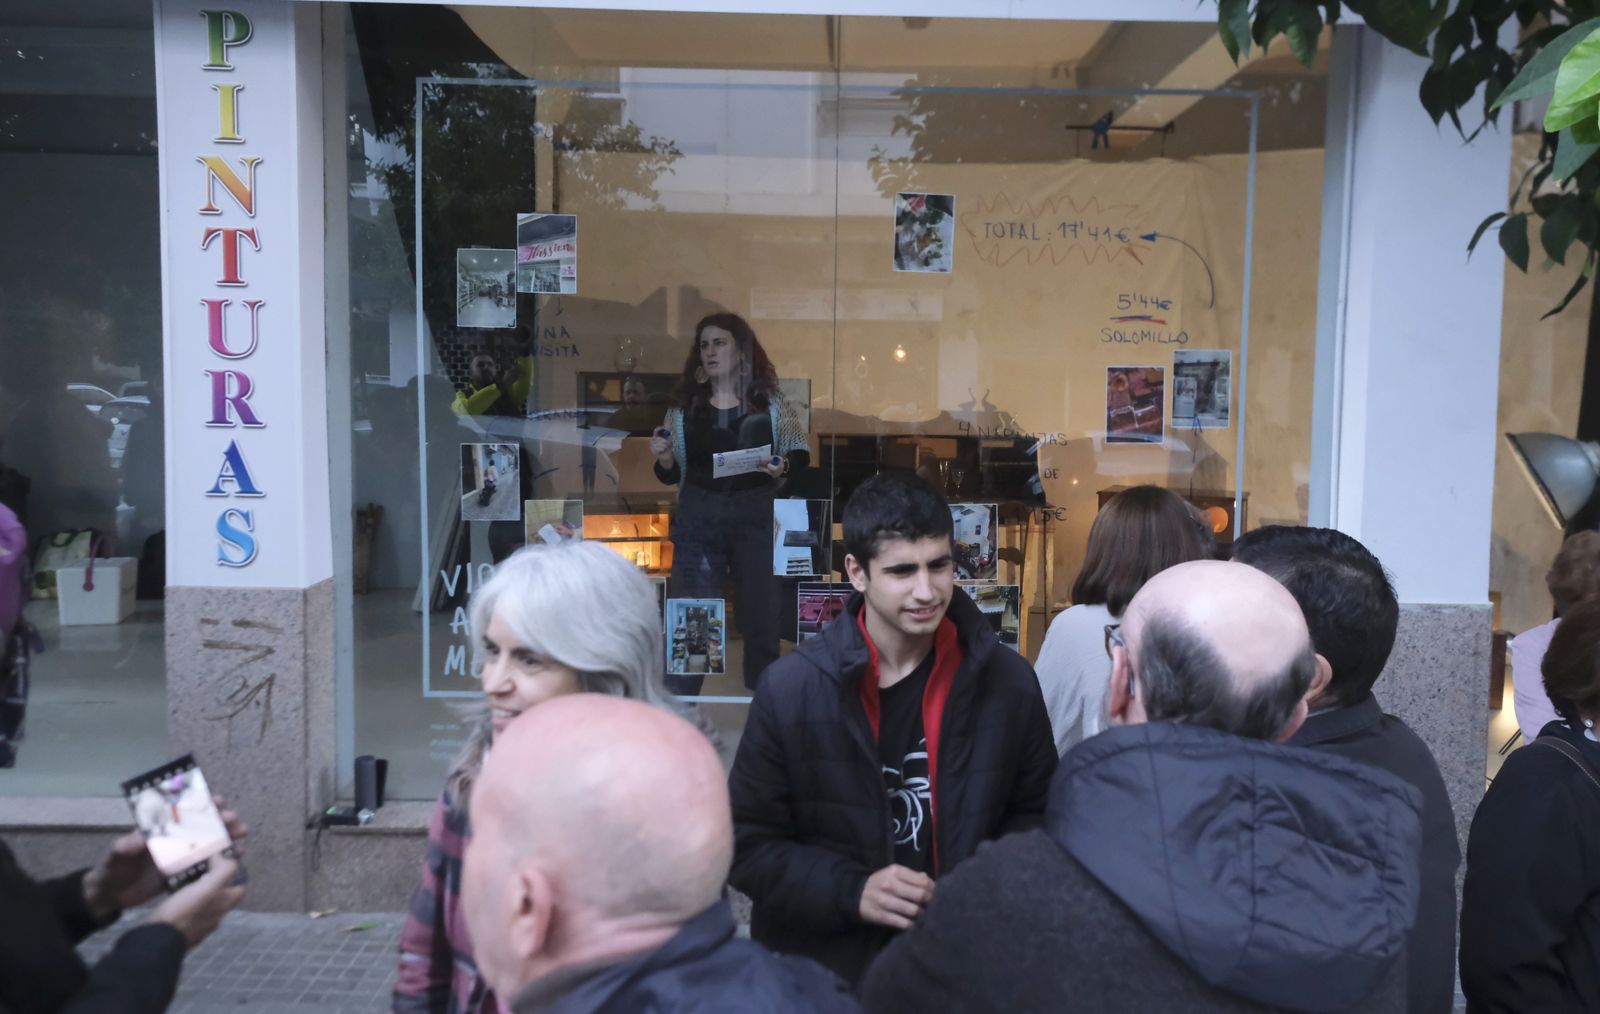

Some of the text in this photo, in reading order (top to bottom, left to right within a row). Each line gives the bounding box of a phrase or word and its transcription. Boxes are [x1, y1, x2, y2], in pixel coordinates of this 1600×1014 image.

[198, 10, 266, 567] PINTURAS
[1117, 293, 1173, 311] 5'44€
[1100, 327, 1189, 345] SOLOMILLO
